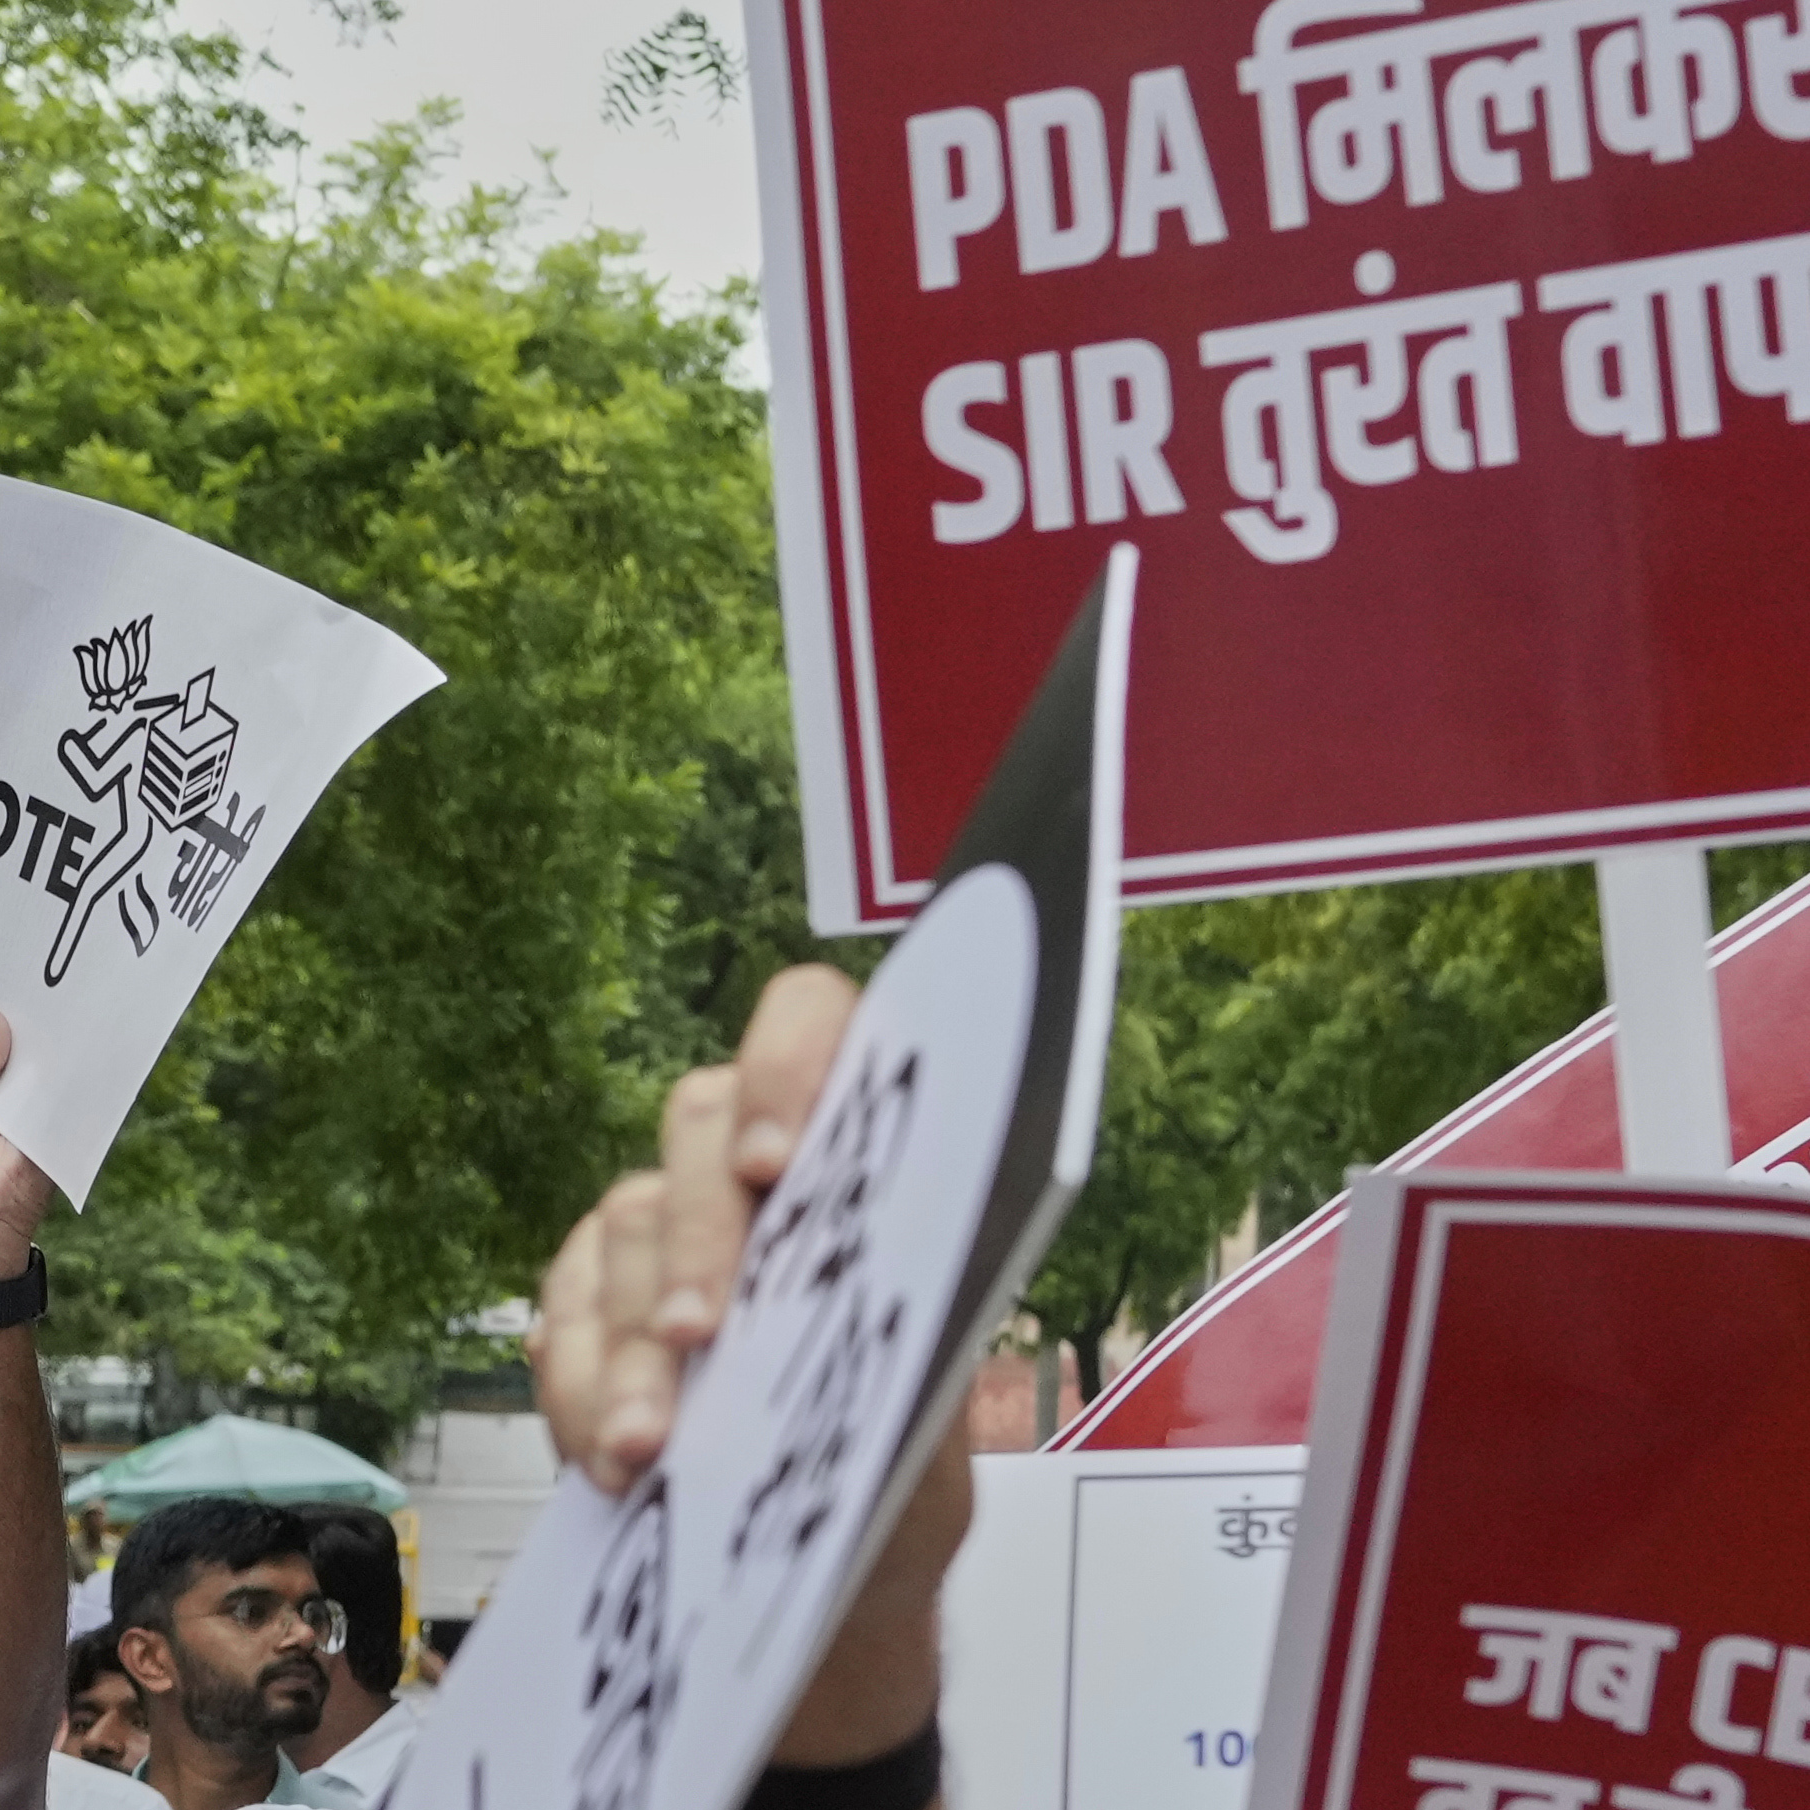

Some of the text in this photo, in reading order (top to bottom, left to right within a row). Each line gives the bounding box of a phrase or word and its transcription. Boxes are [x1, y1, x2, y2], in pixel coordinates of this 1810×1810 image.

[905, 65, 1229, 292] PDA
[920, 232, 1810, 564] SIR तुरंत वाप
[168, 791, 266, 934] चोरी
[1459, 1603, 1680, 1736] जब
[1185, 1730, 1254, 1767] 10
